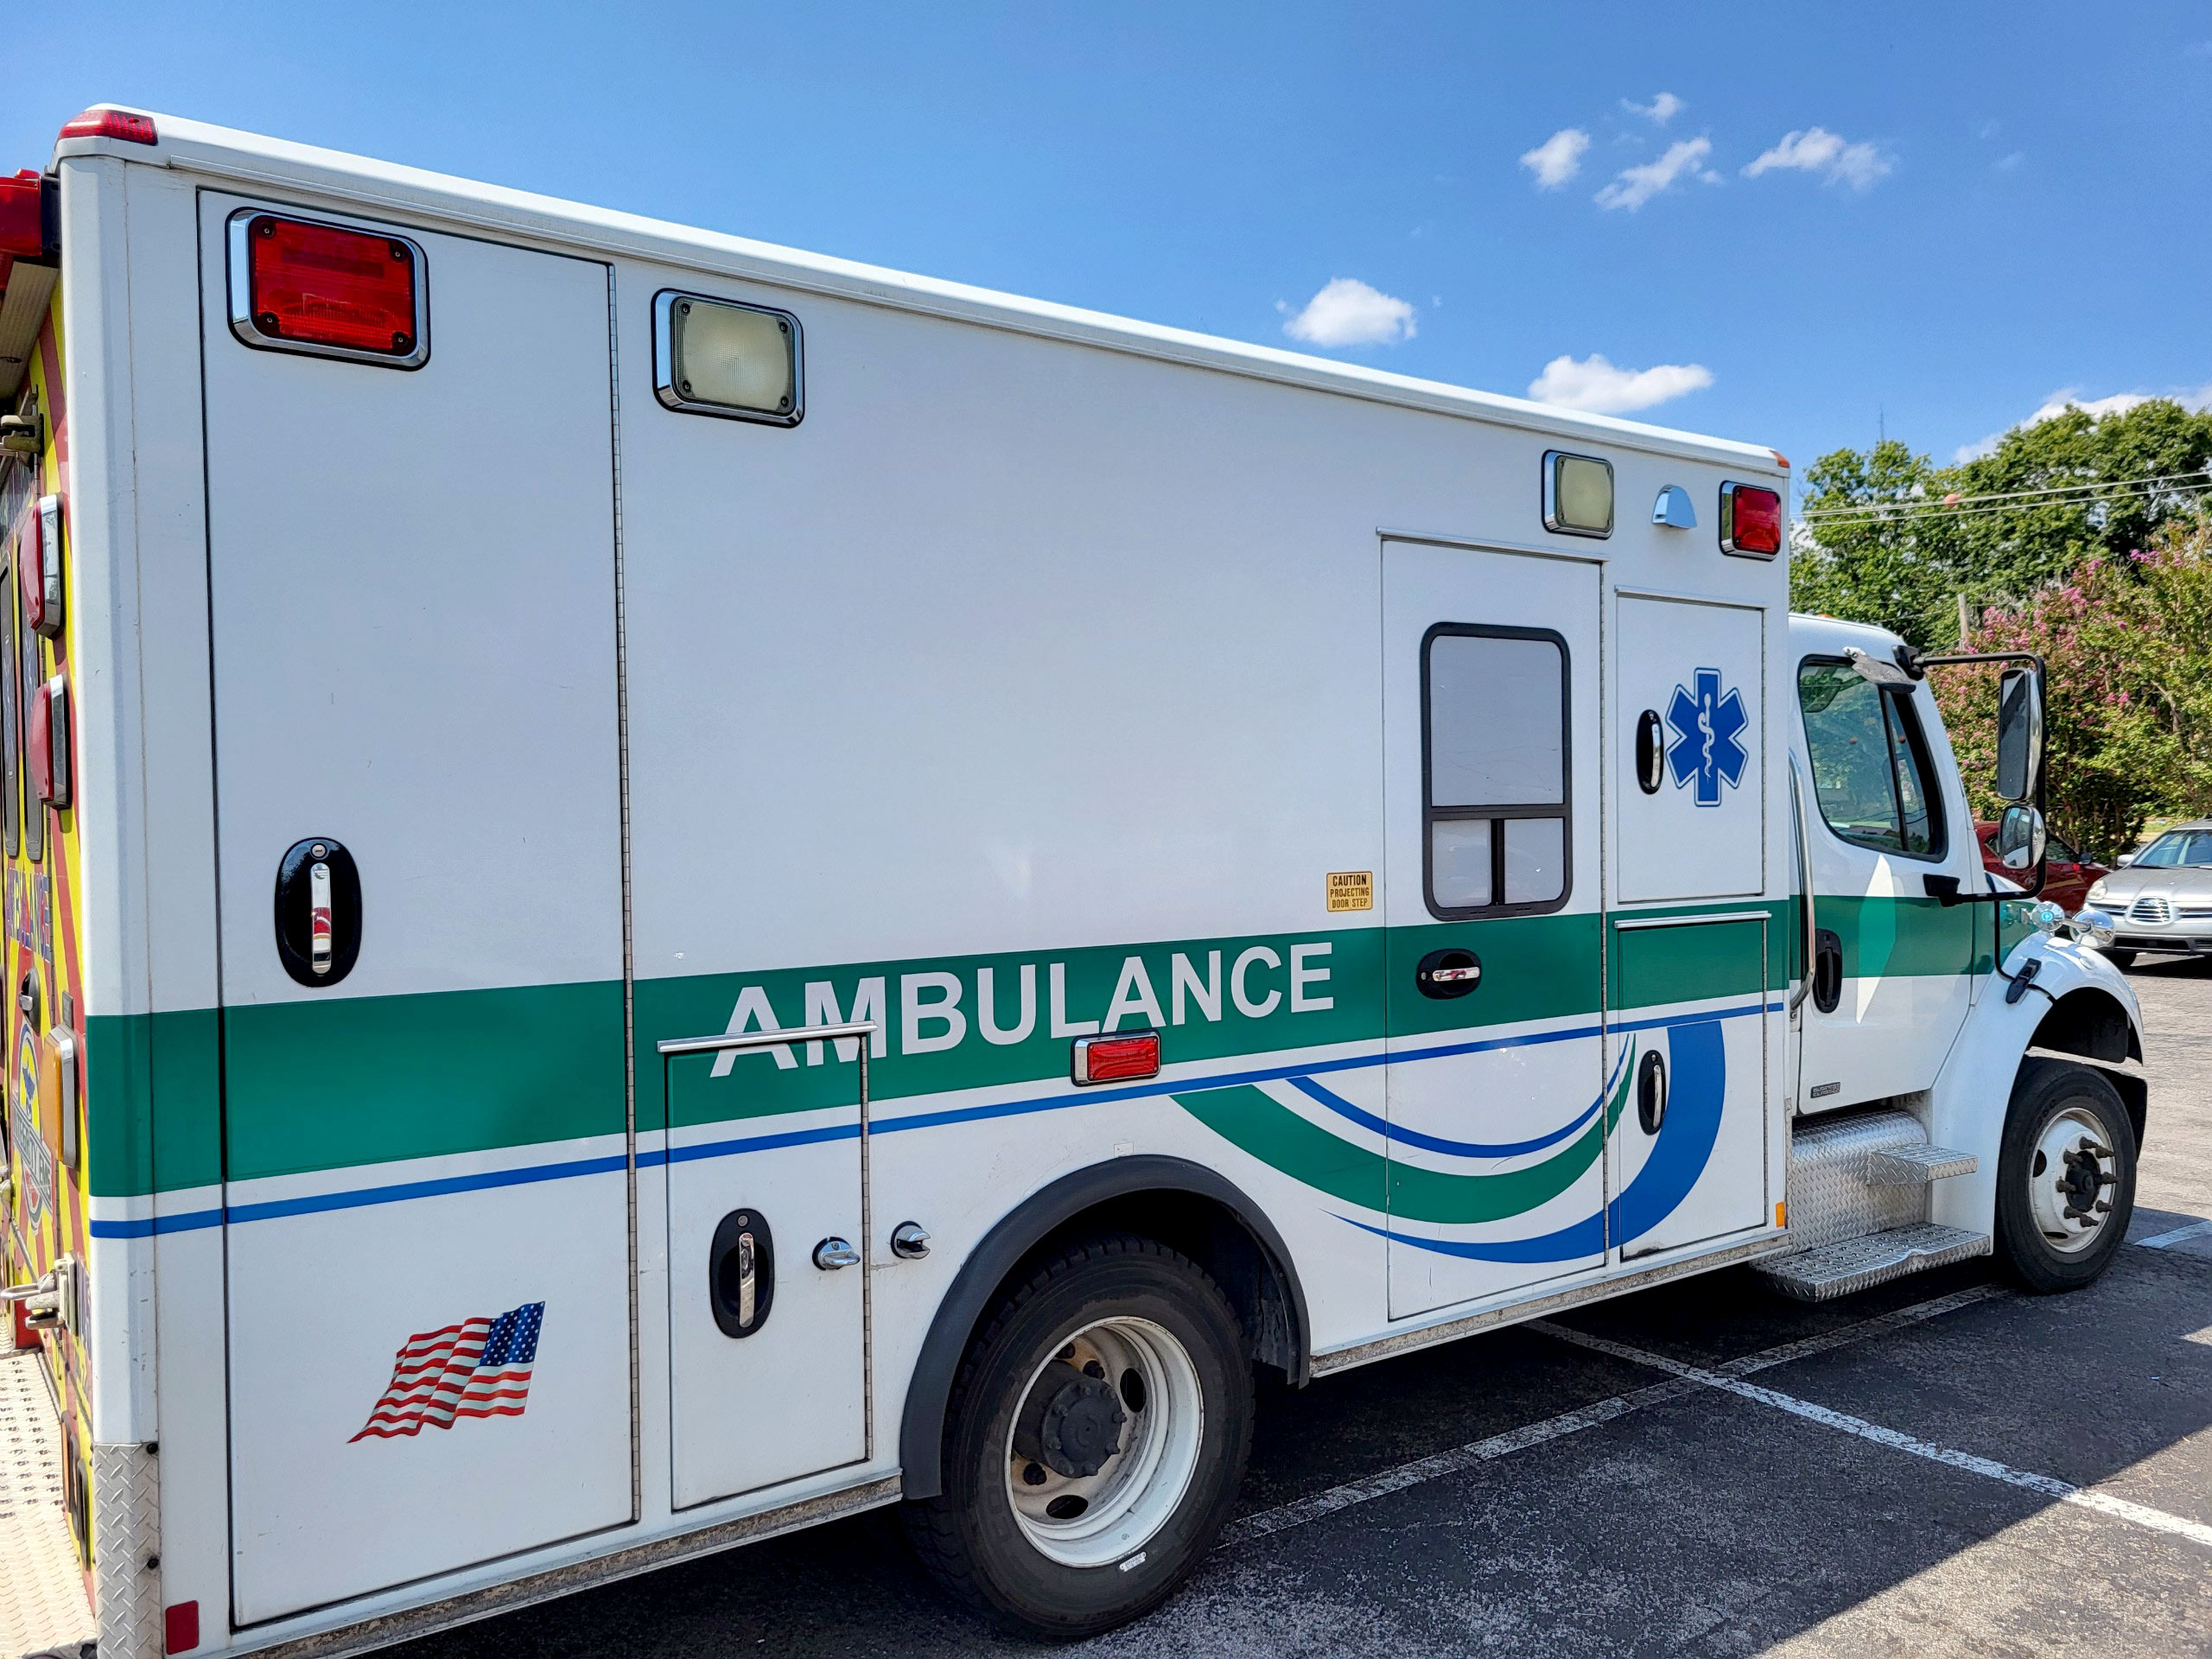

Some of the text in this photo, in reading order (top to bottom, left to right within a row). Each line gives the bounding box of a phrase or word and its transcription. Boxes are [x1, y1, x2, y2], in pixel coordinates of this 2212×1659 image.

[1332, 874, 1367, 887] CAUTION
[1330, 887, 1370, 898] PROJECTING
[1332, 898, 1368, 908] DOOR STEP
[710, 942, 1334, 1077] AMBULANCE
